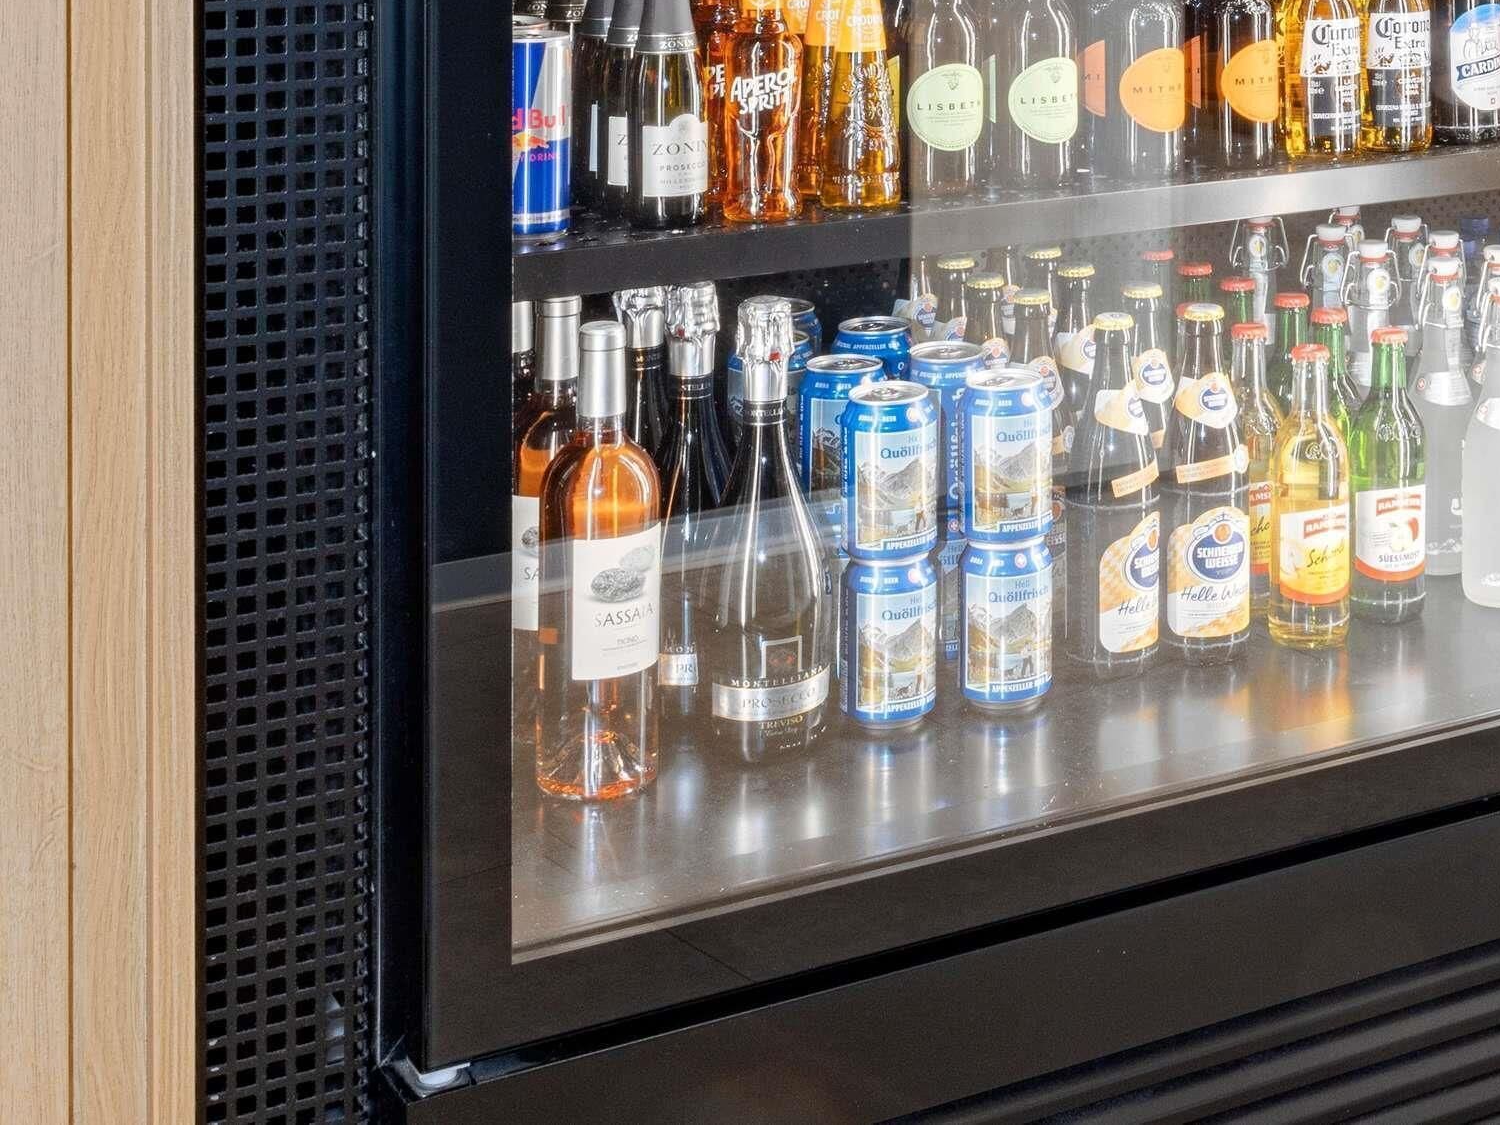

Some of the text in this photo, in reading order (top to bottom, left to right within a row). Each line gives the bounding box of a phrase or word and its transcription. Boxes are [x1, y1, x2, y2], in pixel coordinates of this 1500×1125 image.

[1312, 23, 1359, 48] Coron
[529, 152, 559, 163] DRIN
[1180, 586, 1218, 602] Helle
[760, 714, 804, 731] TREVISO
